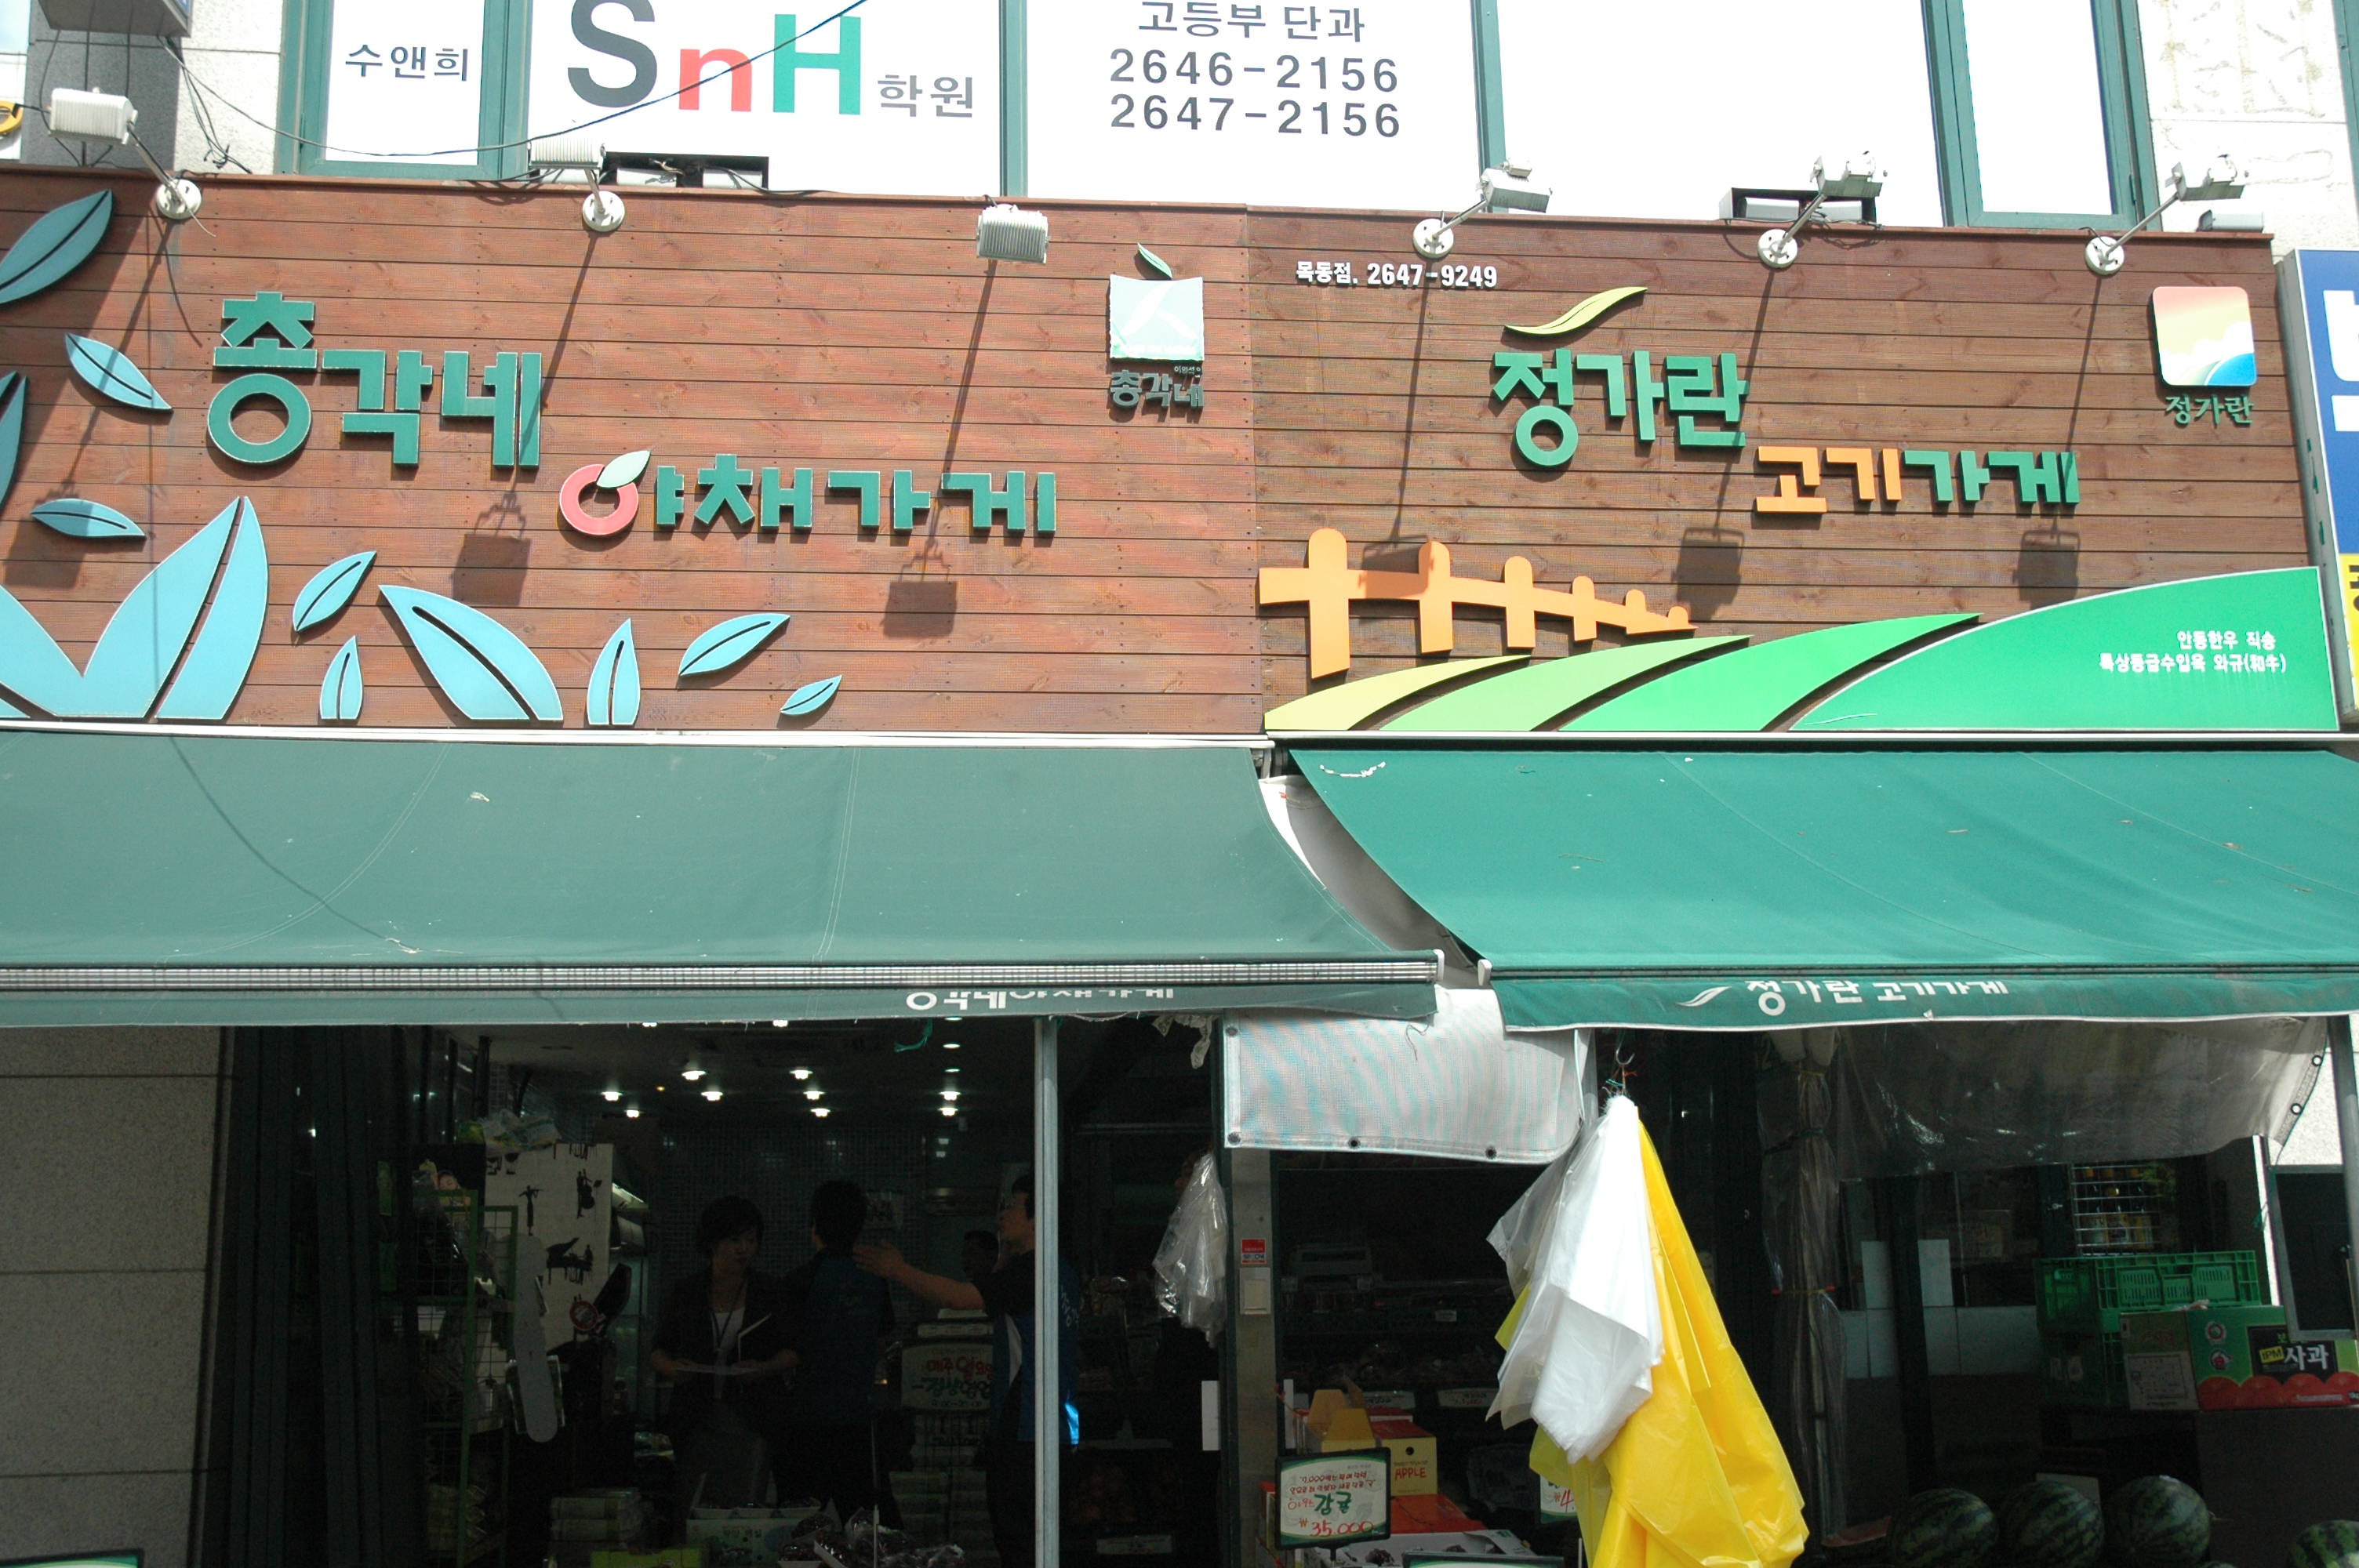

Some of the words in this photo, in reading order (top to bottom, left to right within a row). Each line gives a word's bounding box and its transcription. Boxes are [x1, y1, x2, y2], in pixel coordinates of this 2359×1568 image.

[1139, 2, 1266, 38] 고등부
[1284, 6, 1365, 43] 단과
[345, 43, 469, 82] 수앤희
[569, 0, 860, 115] SnH
[877, 74, 973, 118] 학원
[1110, 49, 1398, 93] 2646-2156
[1111, 93, 1401, 138] 2647-2156
[1367, 262, 1498, 288] 2647-9249
[208, 292, 543, 468] 총각네
[1110, 369, 1205, 408] 총각네
[1493, 348, 1750, 467] 정가란
[2165, 394, 2255, 426] 정가란
[558, 452, 1056, 536] 야채가게
[1756, 445, 2081, 514] 고기가게
[2177, 630, 2238, 651] 안동한우
[2246, 630, 2277, 651] 직송
[1744, 980, 1864, 1017] 정가란
[2283, 1343, 2329, 1370] 사과
[1394, 1466, 1427, 1481] APPLE
